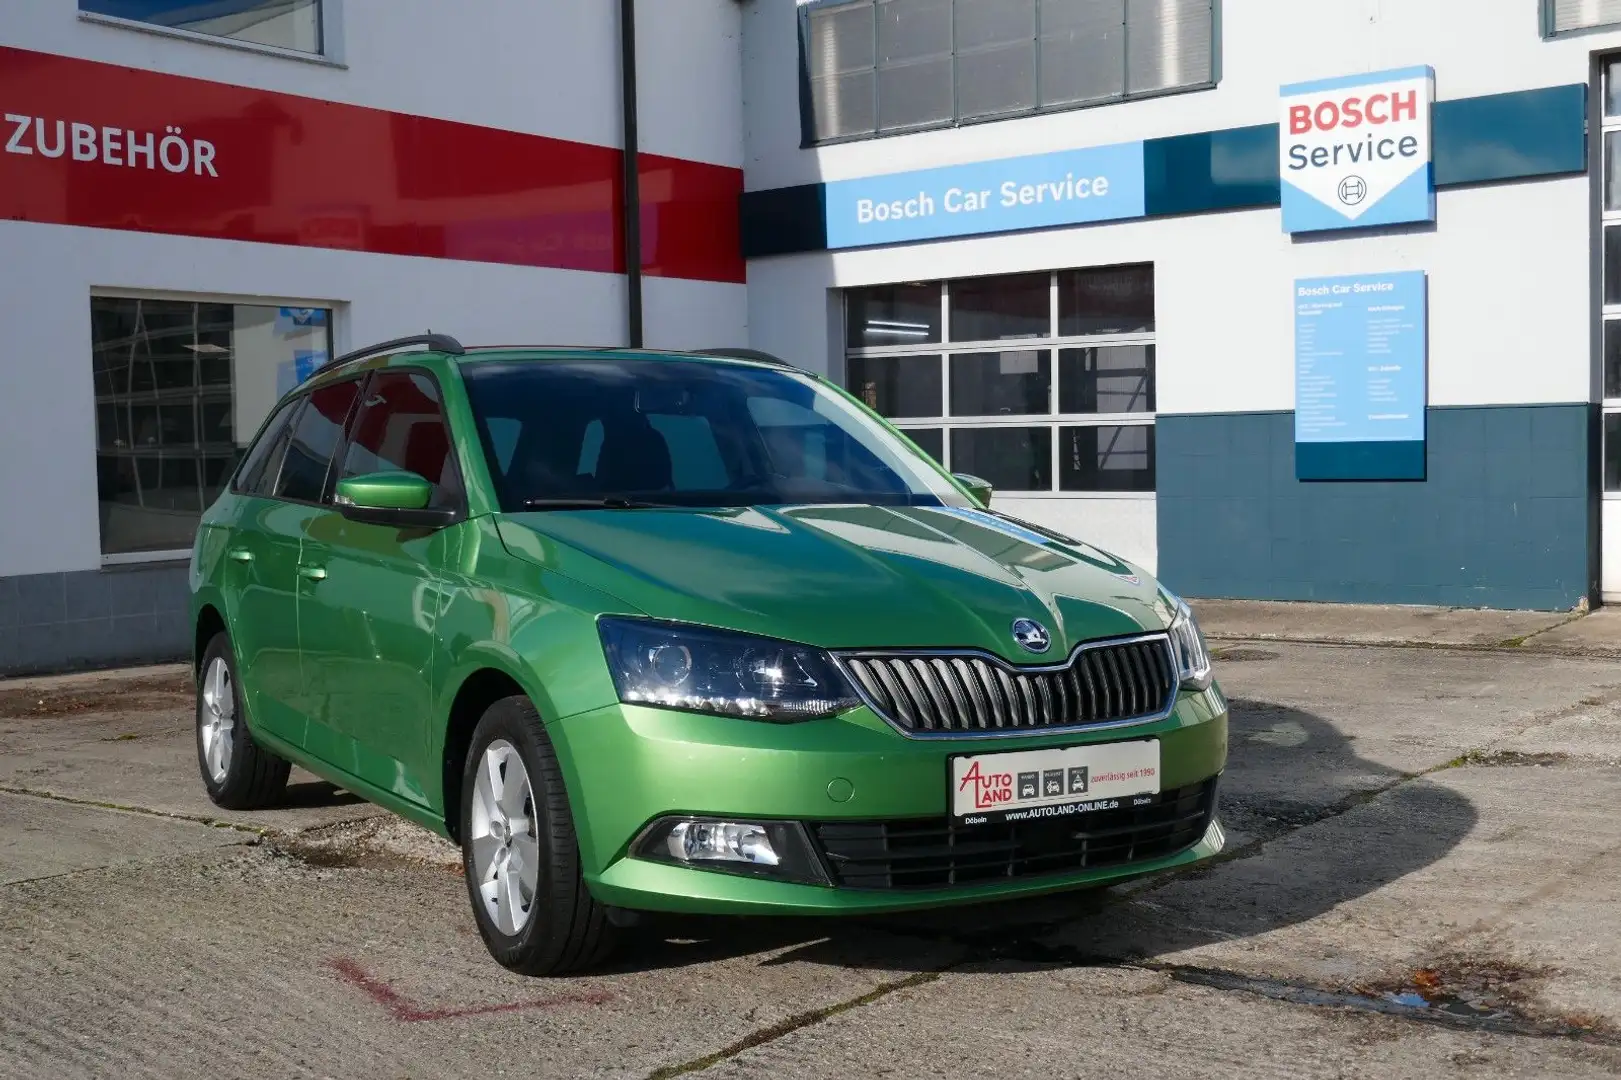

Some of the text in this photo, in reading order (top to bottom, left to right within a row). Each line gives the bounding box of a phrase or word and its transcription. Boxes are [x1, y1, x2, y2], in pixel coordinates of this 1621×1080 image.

[1289, 90, 1417, 135] BOSCH
[4, 113, 219, 178] ZUBEHÖR
[1288, 131, 1418, 171] Service
[857, 173, 1109, 224] Bosch Car Service
[1298, 281, 1394, 296] Bosch Car Service
[960, 761, 1012, 791] AUTO
[975, 787, 1012, 808] LAND
[1005, 799, 1119, 822] www.AUTOLAND-ONLINE.de
